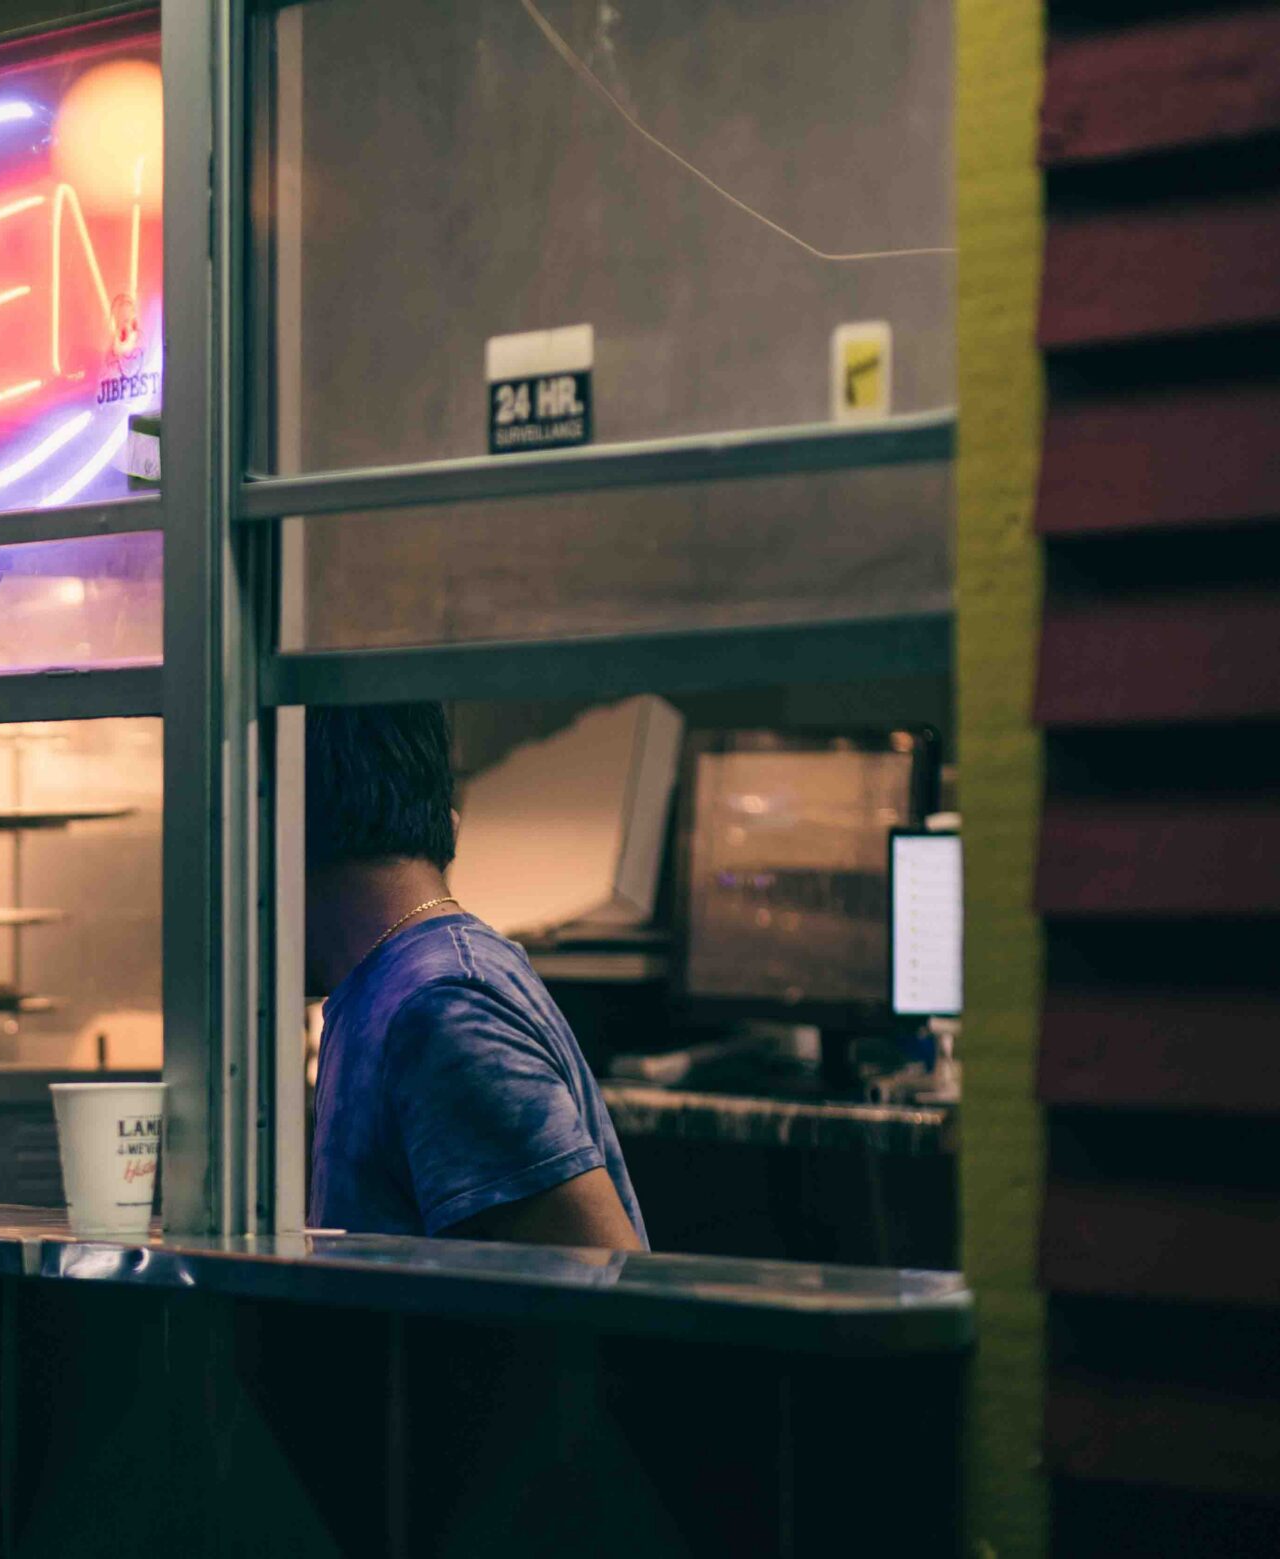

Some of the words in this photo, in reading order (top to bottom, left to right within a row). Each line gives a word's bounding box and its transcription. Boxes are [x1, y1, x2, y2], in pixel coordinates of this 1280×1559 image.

[97, 372, 160, 404] JIBFEST
[495, 383, 531, 424] 24
[536, 376, 584, 417] HR.
